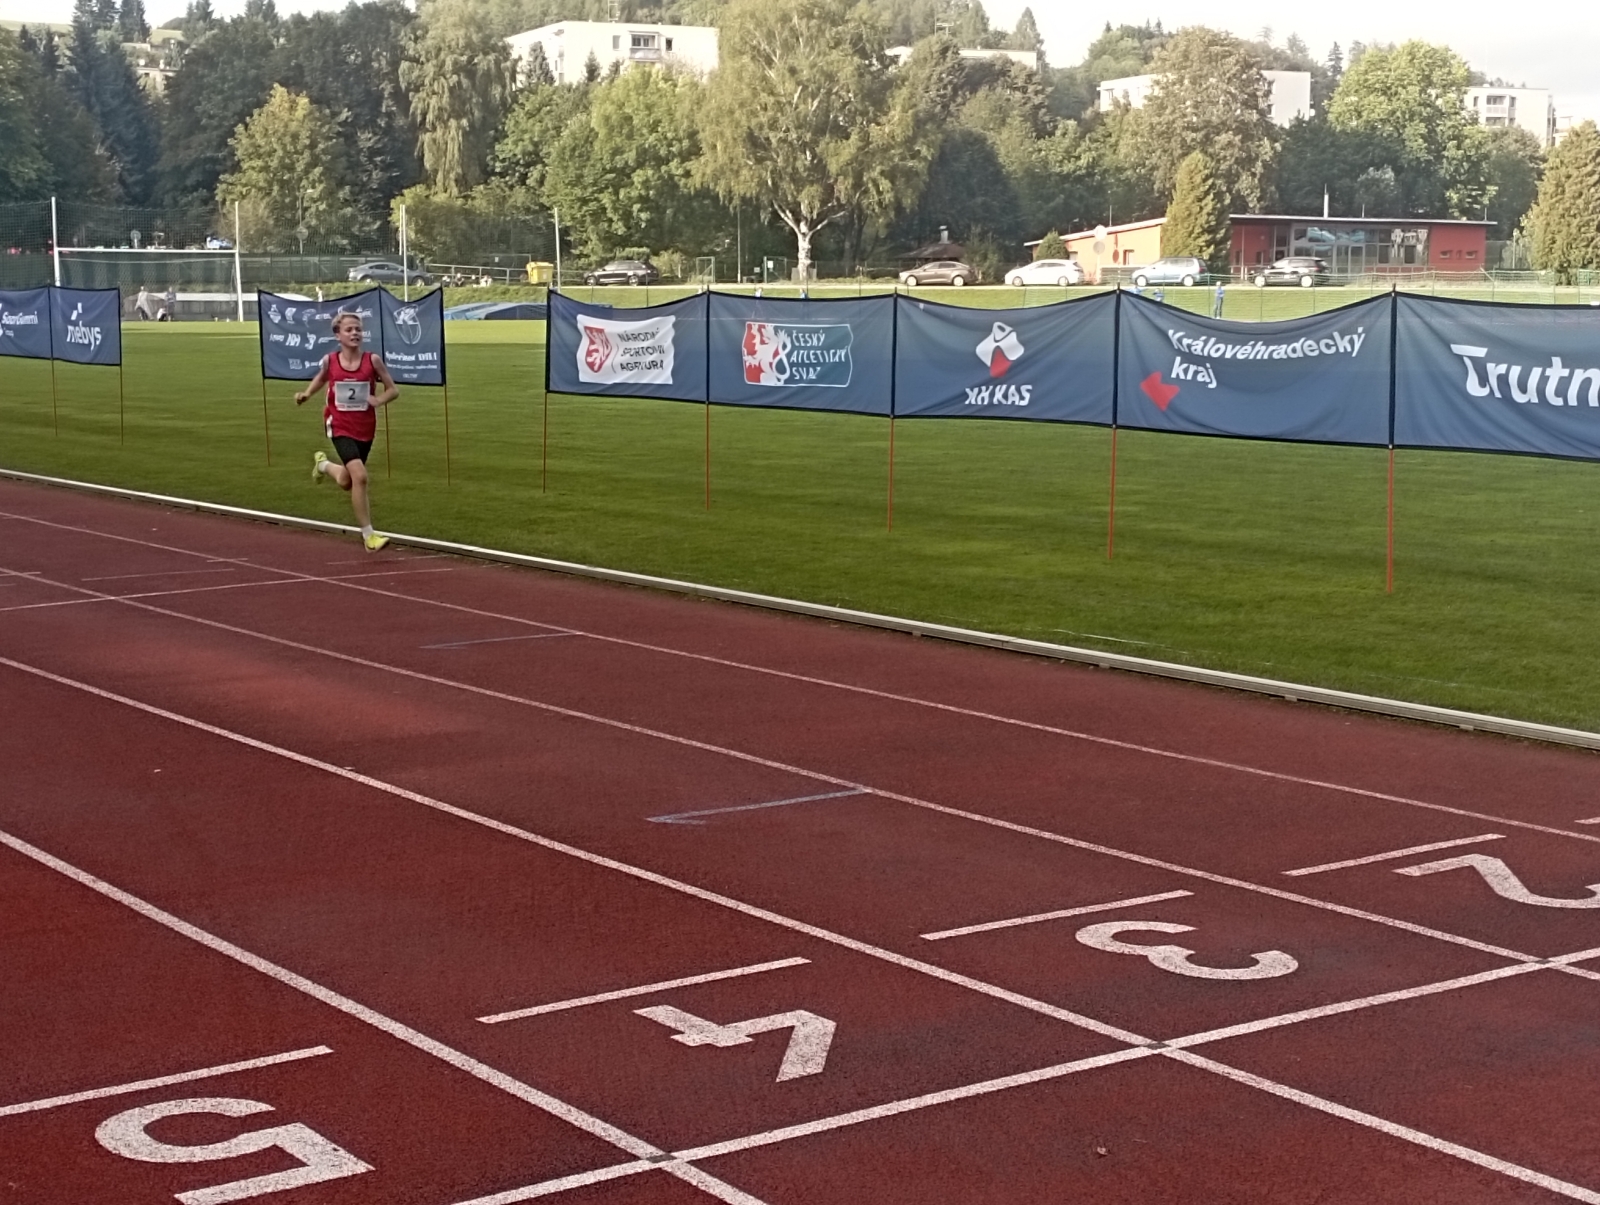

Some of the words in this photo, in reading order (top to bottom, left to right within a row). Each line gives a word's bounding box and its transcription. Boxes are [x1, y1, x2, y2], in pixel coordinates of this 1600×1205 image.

[792, 329, 825, 347] ČESKÝ
[1168, 327, 1366, 360] Královéhradecký
[792, 366, 821, 380] SVAZ
[1170, 357, 1217, 388] kraj
[348, 388, 356, 400] 2
[1075, 920, 1299, 980] 3
[632, 1004, 837, 1083] 4
[94, 1097, 376, 1205] 5
